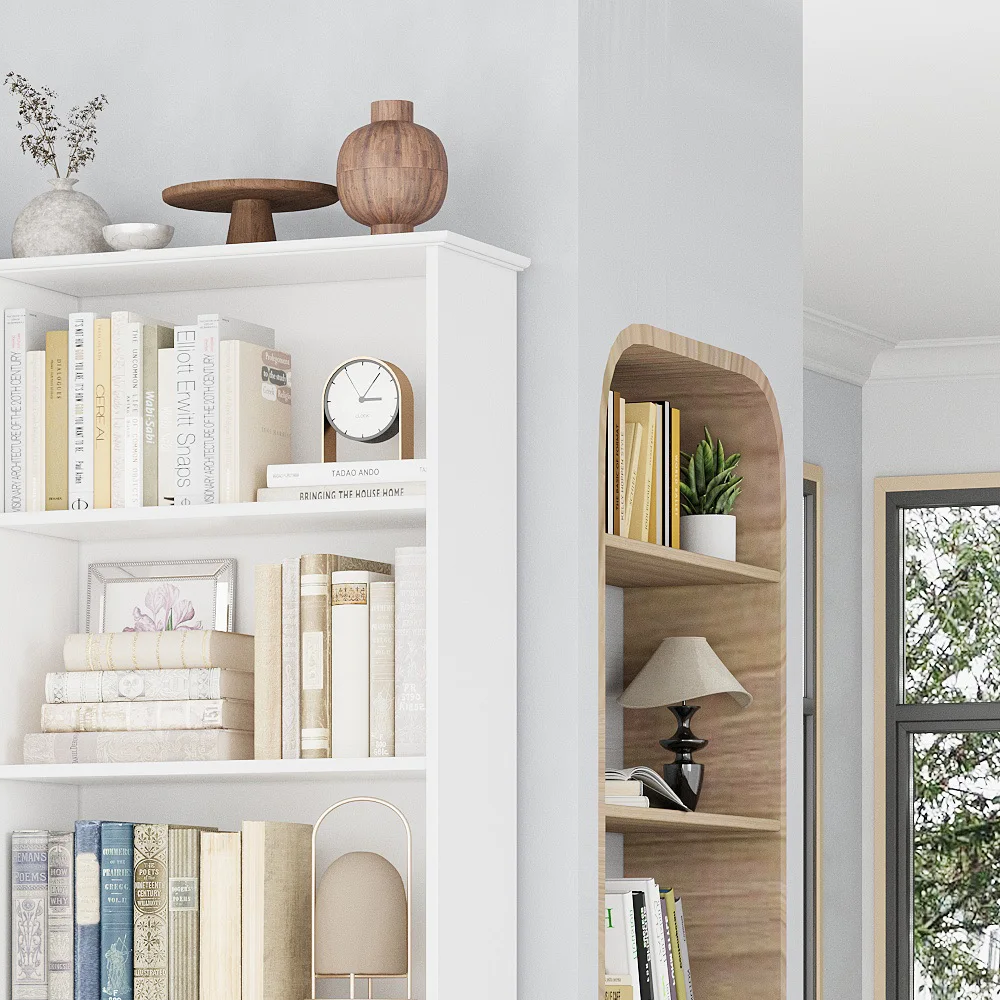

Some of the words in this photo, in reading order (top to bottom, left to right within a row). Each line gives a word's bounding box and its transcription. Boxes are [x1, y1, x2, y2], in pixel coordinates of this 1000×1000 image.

[10, 351, 22, 386] CENTURY
[177, 330, 196, 375] Elliott
[203, 354, 215, 387] CENTURY
[10, 386, 22, 406] 20TH
[177, 380, 196, 427] Erwitt
[203, 386, 215, 405] 20TH
[10, 406, 22, 421] THE
[10, 420, 22, 430] OF
[96, 384, 105, 449] CEREAL
[145, 390, 156, 445] Wabi-Sabi
[203, 406, 215, 419] THE
[10, 430, 22, 480] ARCHITECTURE
[175, 433, 196, 488] Snaps
[203, 428, 215, 475] ARCHITECTURE
[616, 457, 620, 468] OF
[332, 469, 356, 477] TADAO
[359, 468, 380, 476] ANDO
[300, 491, 336, 501] BRINGING
[339, 490, 353, 499] THE
[356, 488, 380, 498] HOUSE
[382, 488, 404, 497] HOME
